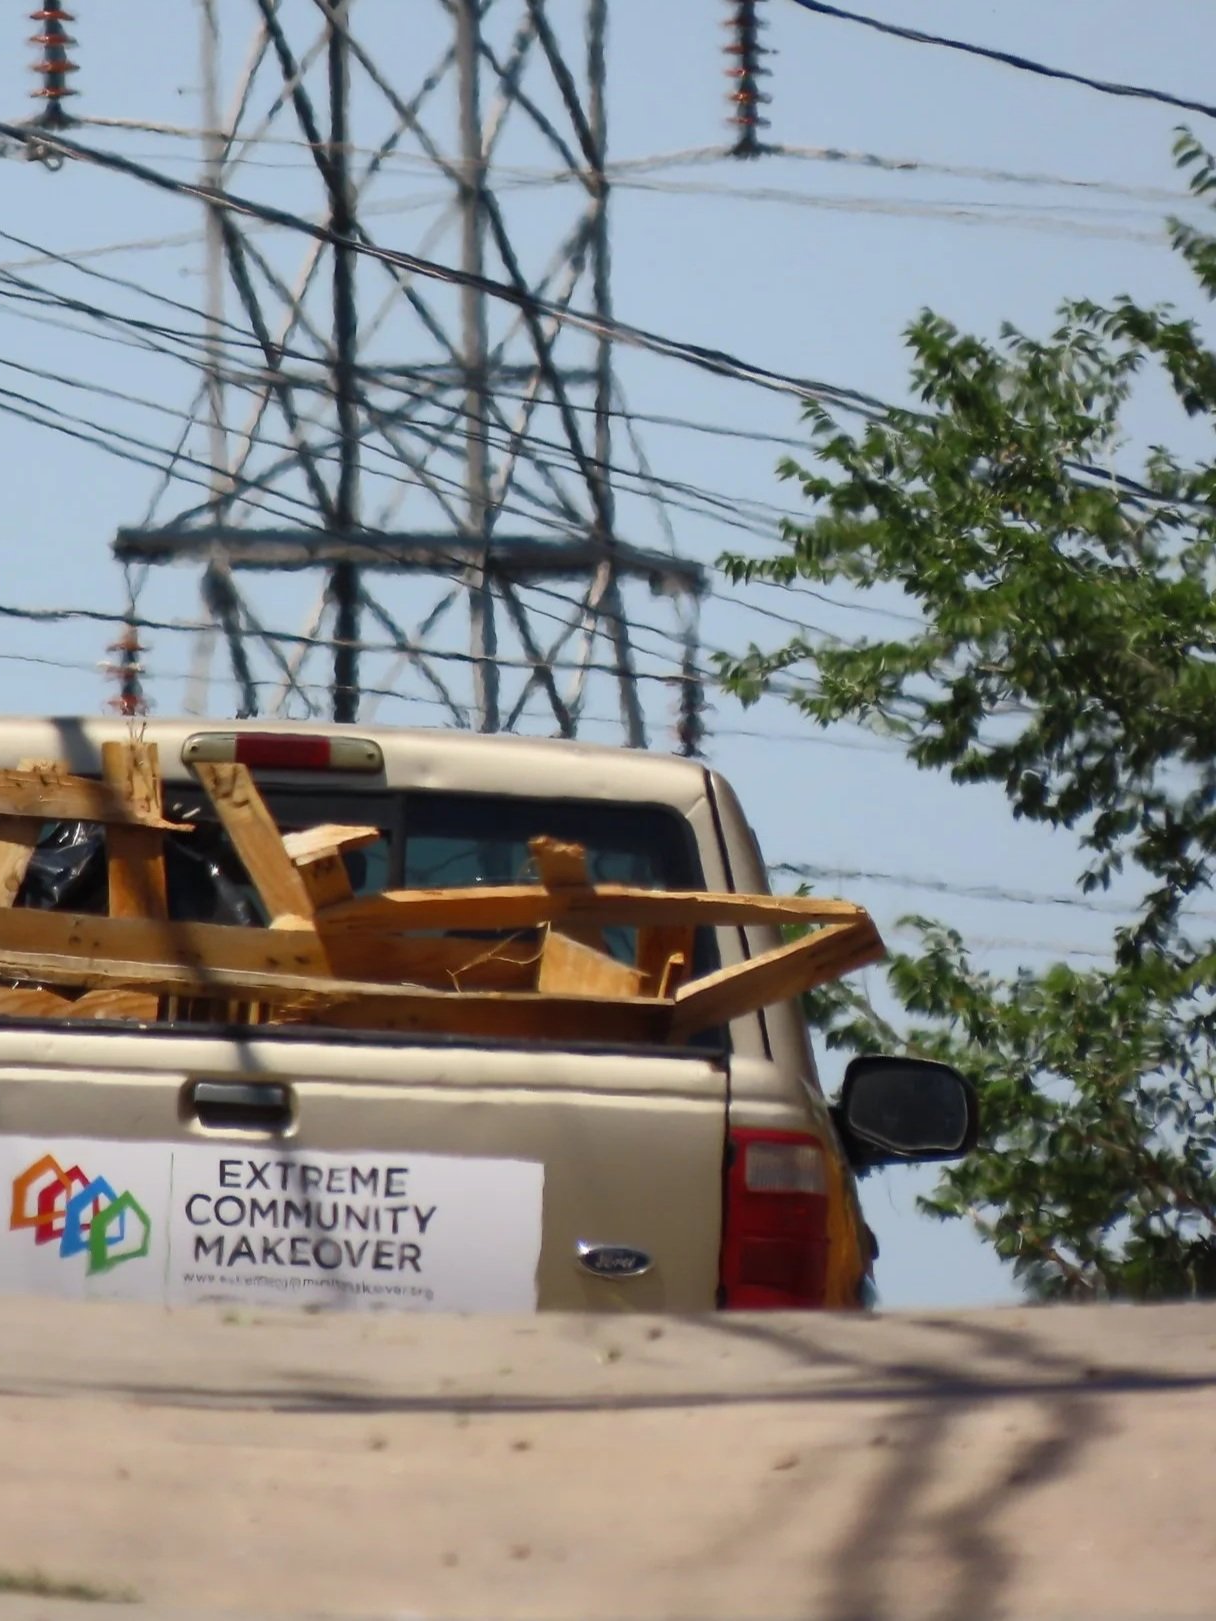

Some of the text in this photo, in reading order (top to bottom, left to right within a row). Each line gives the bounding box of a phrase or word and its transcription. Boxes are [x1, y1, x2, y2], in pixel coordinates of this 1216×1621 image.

[219, 1159, 410, 1198] EXTREME
[185, 1193, 438, 1235] COMMUNITY
[193, 1234, 423, 1273] MAKEOVER
